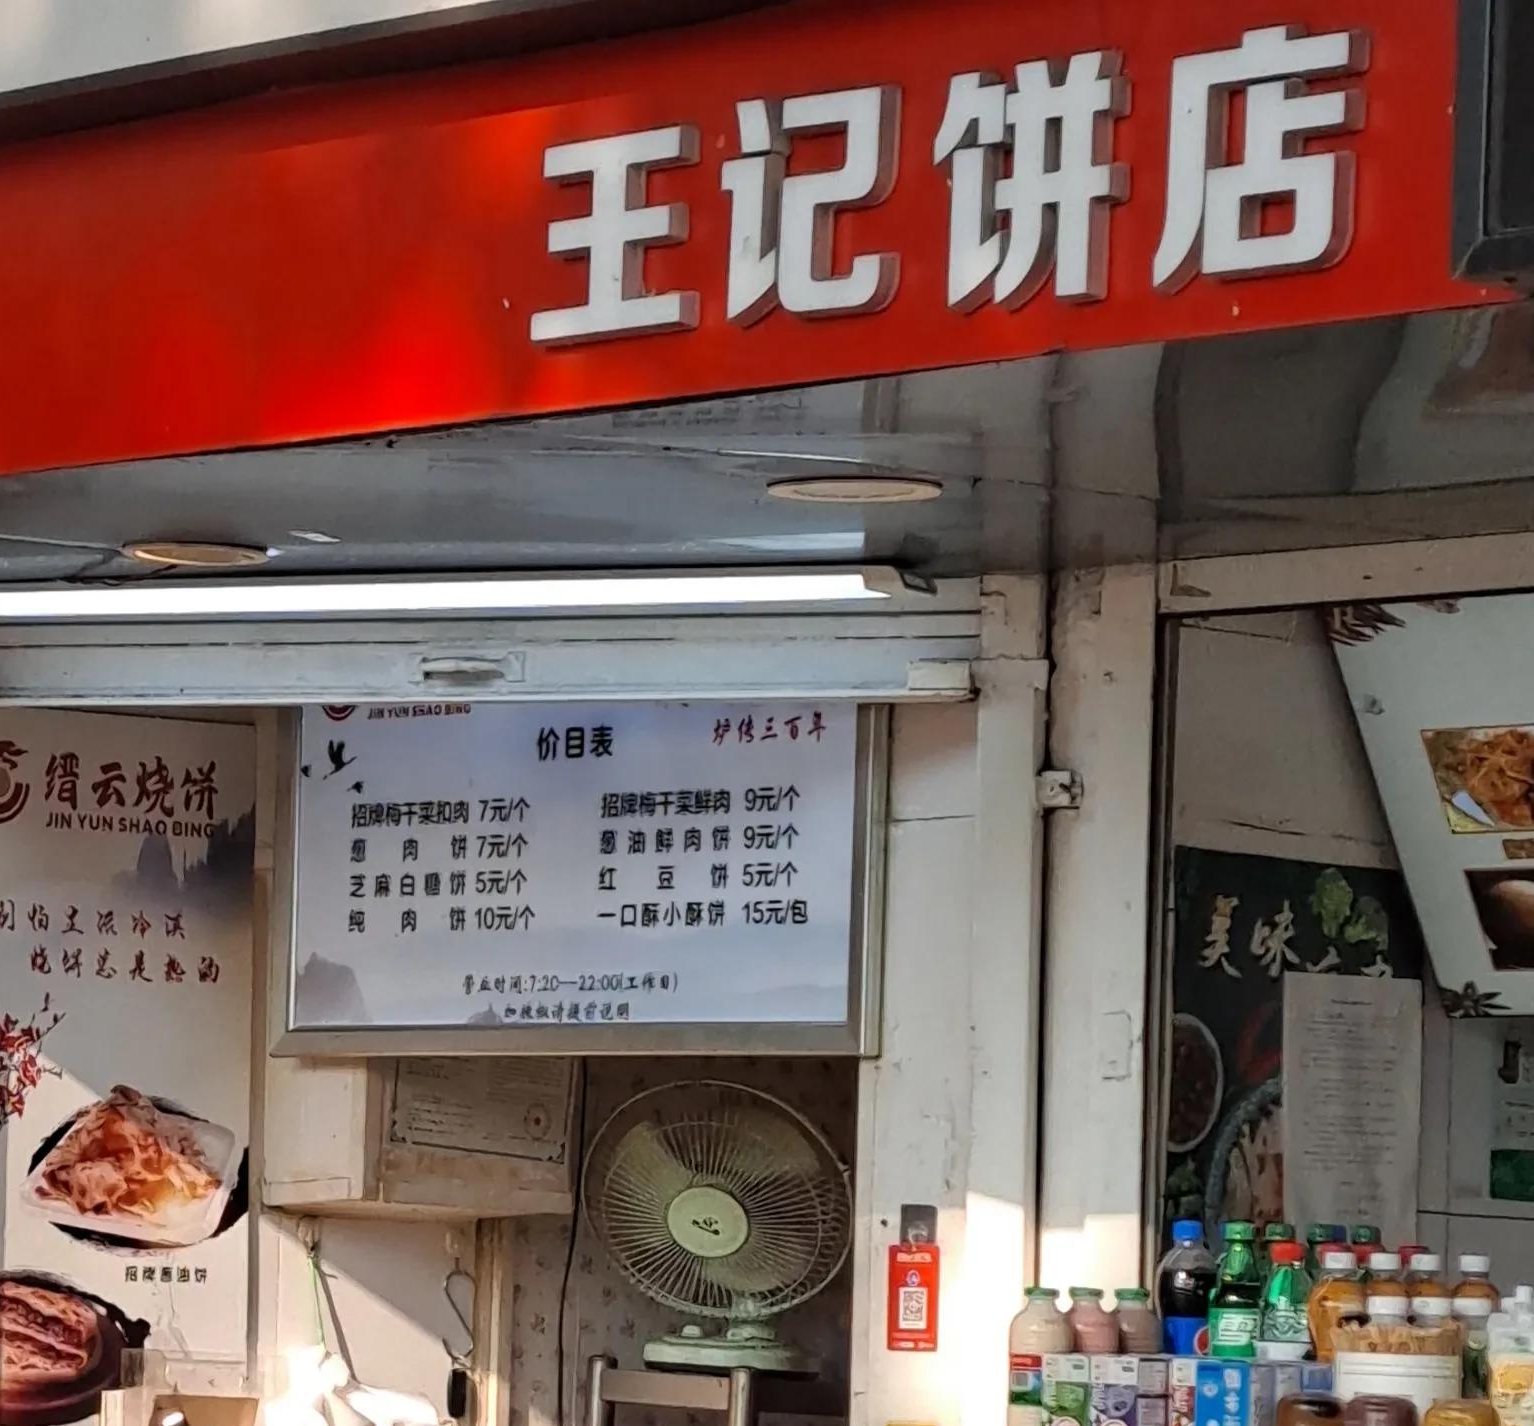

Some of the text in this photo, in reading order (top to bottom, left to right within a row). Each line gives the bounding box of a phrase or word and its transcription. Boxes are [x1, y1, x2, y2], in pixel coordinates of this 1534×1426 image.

[530, 24, 1369, 345] 王记饼店
[536, 724, 614, 762] 价目表
[44, 751, 219, 820] 缙云烧饼
[744, 784, 800, 813] 9元/个
[478, 797, 530, 824] 7元/个
[46, 812, 215, 838] JIN YUN SHAO BING
[743, 823, 799, 850] 9元/个
[477, 833, 528, 860] 7元/个
[476, 868, 527, 895] 5元/个
[742, 861, 798, 888] 5元/个
[475, 904, 535, 932] 10元/个
[596, 900, 808, 928] 一口酥小酥饼 15元/包
